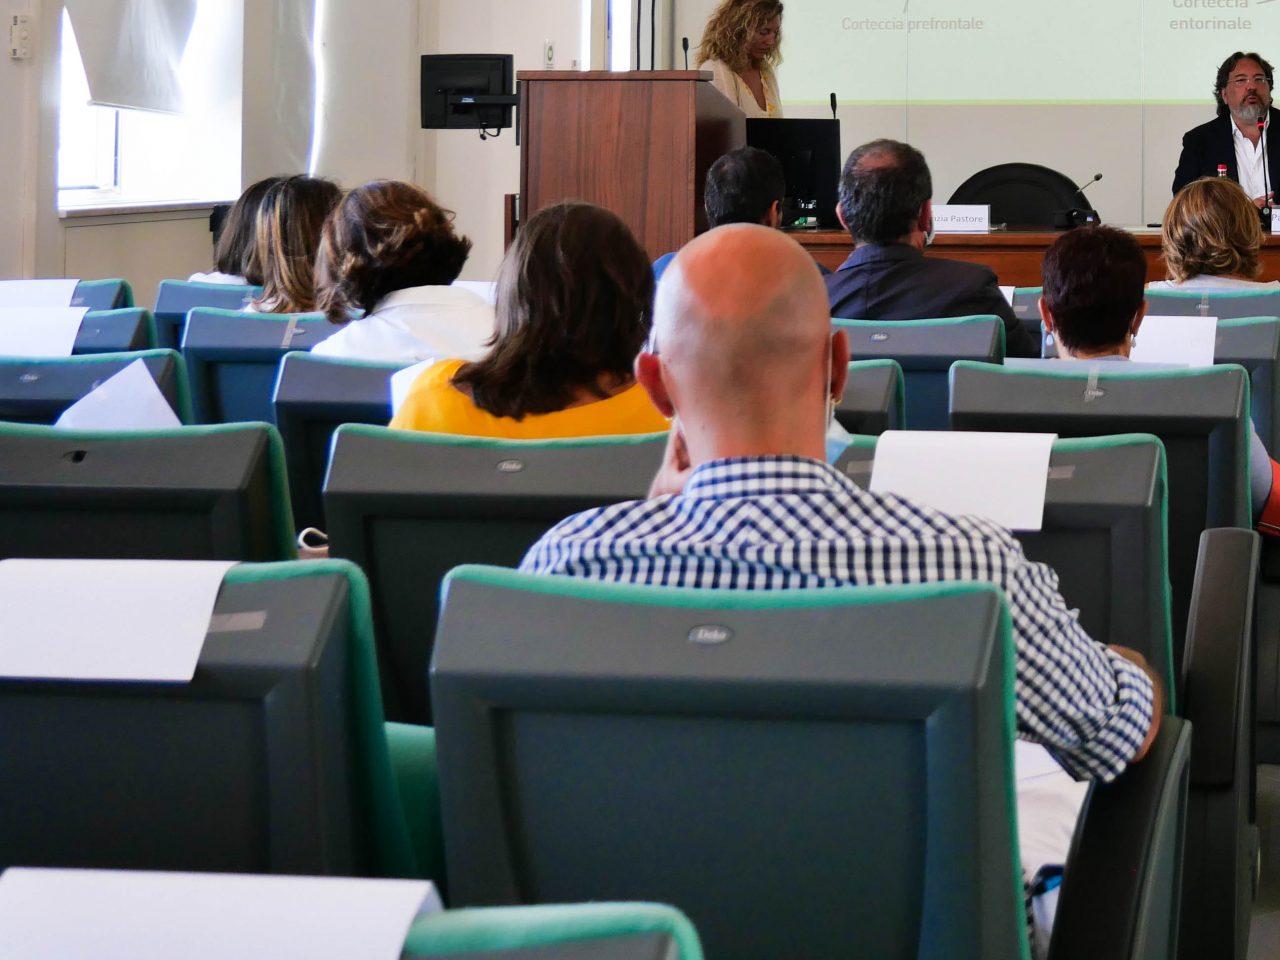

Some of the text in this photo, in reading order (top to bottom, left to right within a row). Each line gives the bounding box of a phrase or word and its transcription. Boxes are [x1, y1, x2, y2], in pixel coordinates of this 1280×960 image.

[841, 16, 984, 33] Corteccia prefrontale
[1169, 15, 1252, 31] entorinale
[950, 214, 984, 223] Pastore
